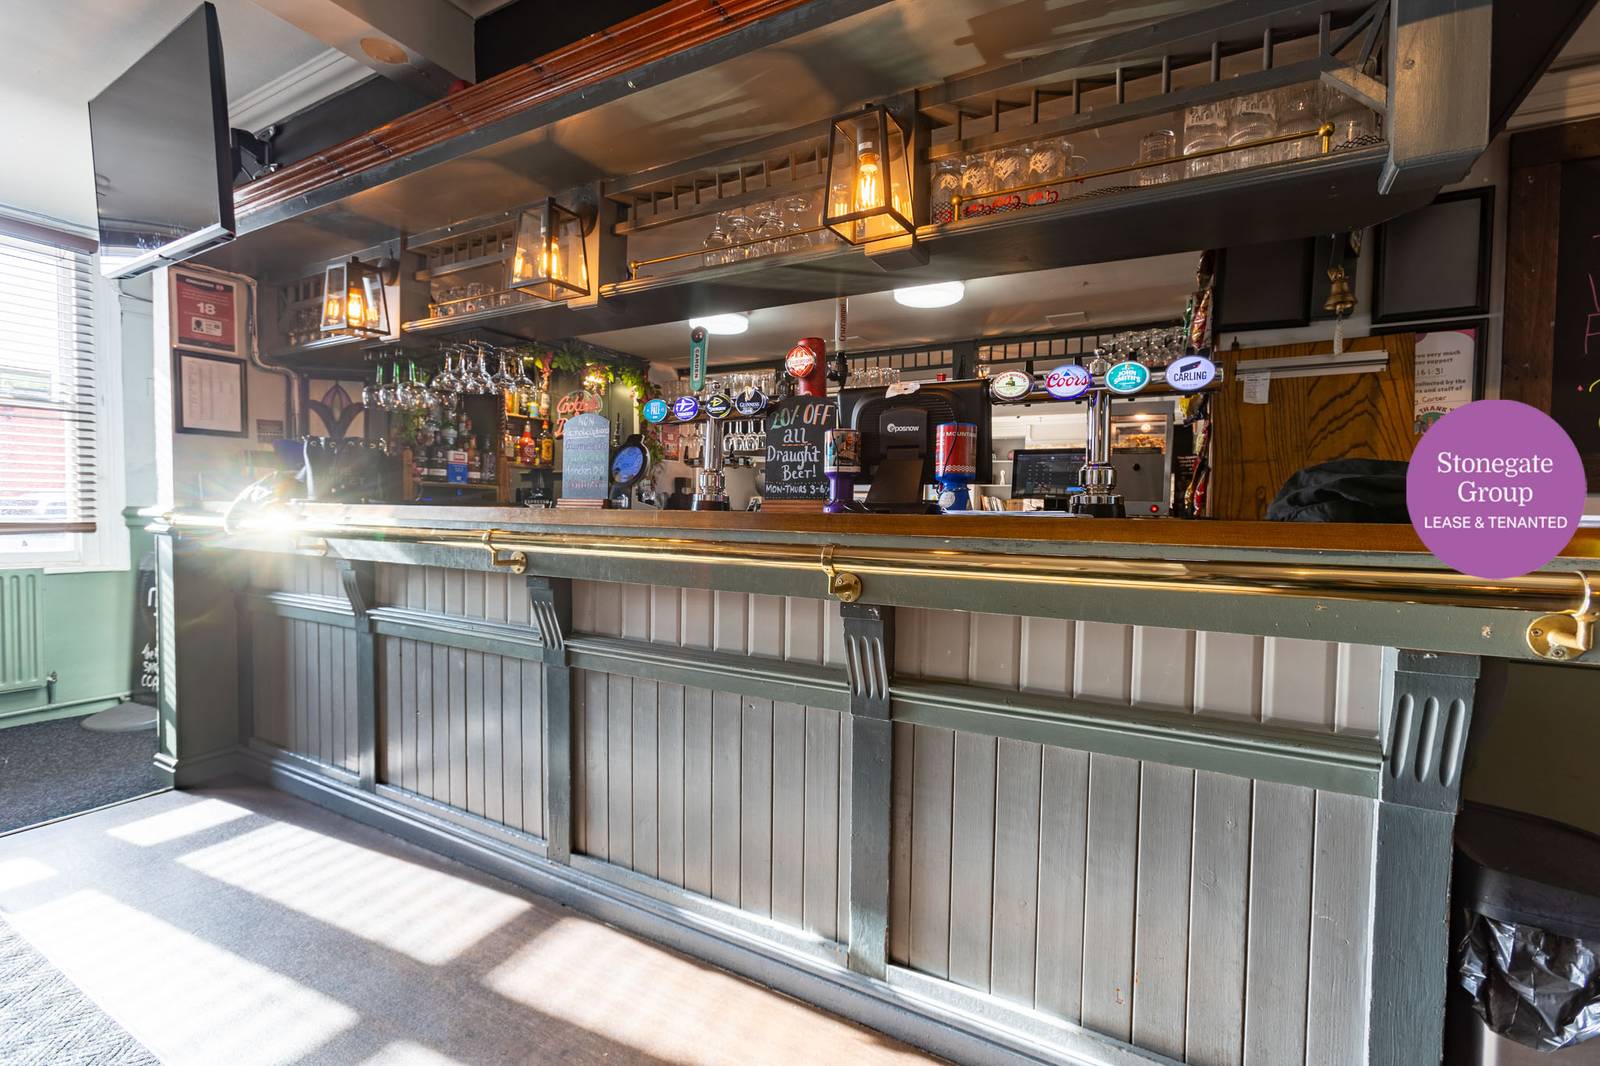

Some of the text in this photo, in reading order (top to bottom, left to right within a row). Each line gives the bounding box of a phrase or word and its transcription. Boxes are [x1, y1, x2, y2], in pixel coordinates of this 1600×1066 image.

[197, 302, 216, 315] 18
[1046, 375, 1089, 388] Coors
[1173, 371, 1207, 382] CARLING
[803, 403, 835, 426] OFF
[1419, 405, 1448, 414] THANK
[783, 427, 808, 444] all
[766, 445, 821, 470] Draught
[781, 464, 817, 482] Beer!
[766, 484, 807, 494] MON-THURS
